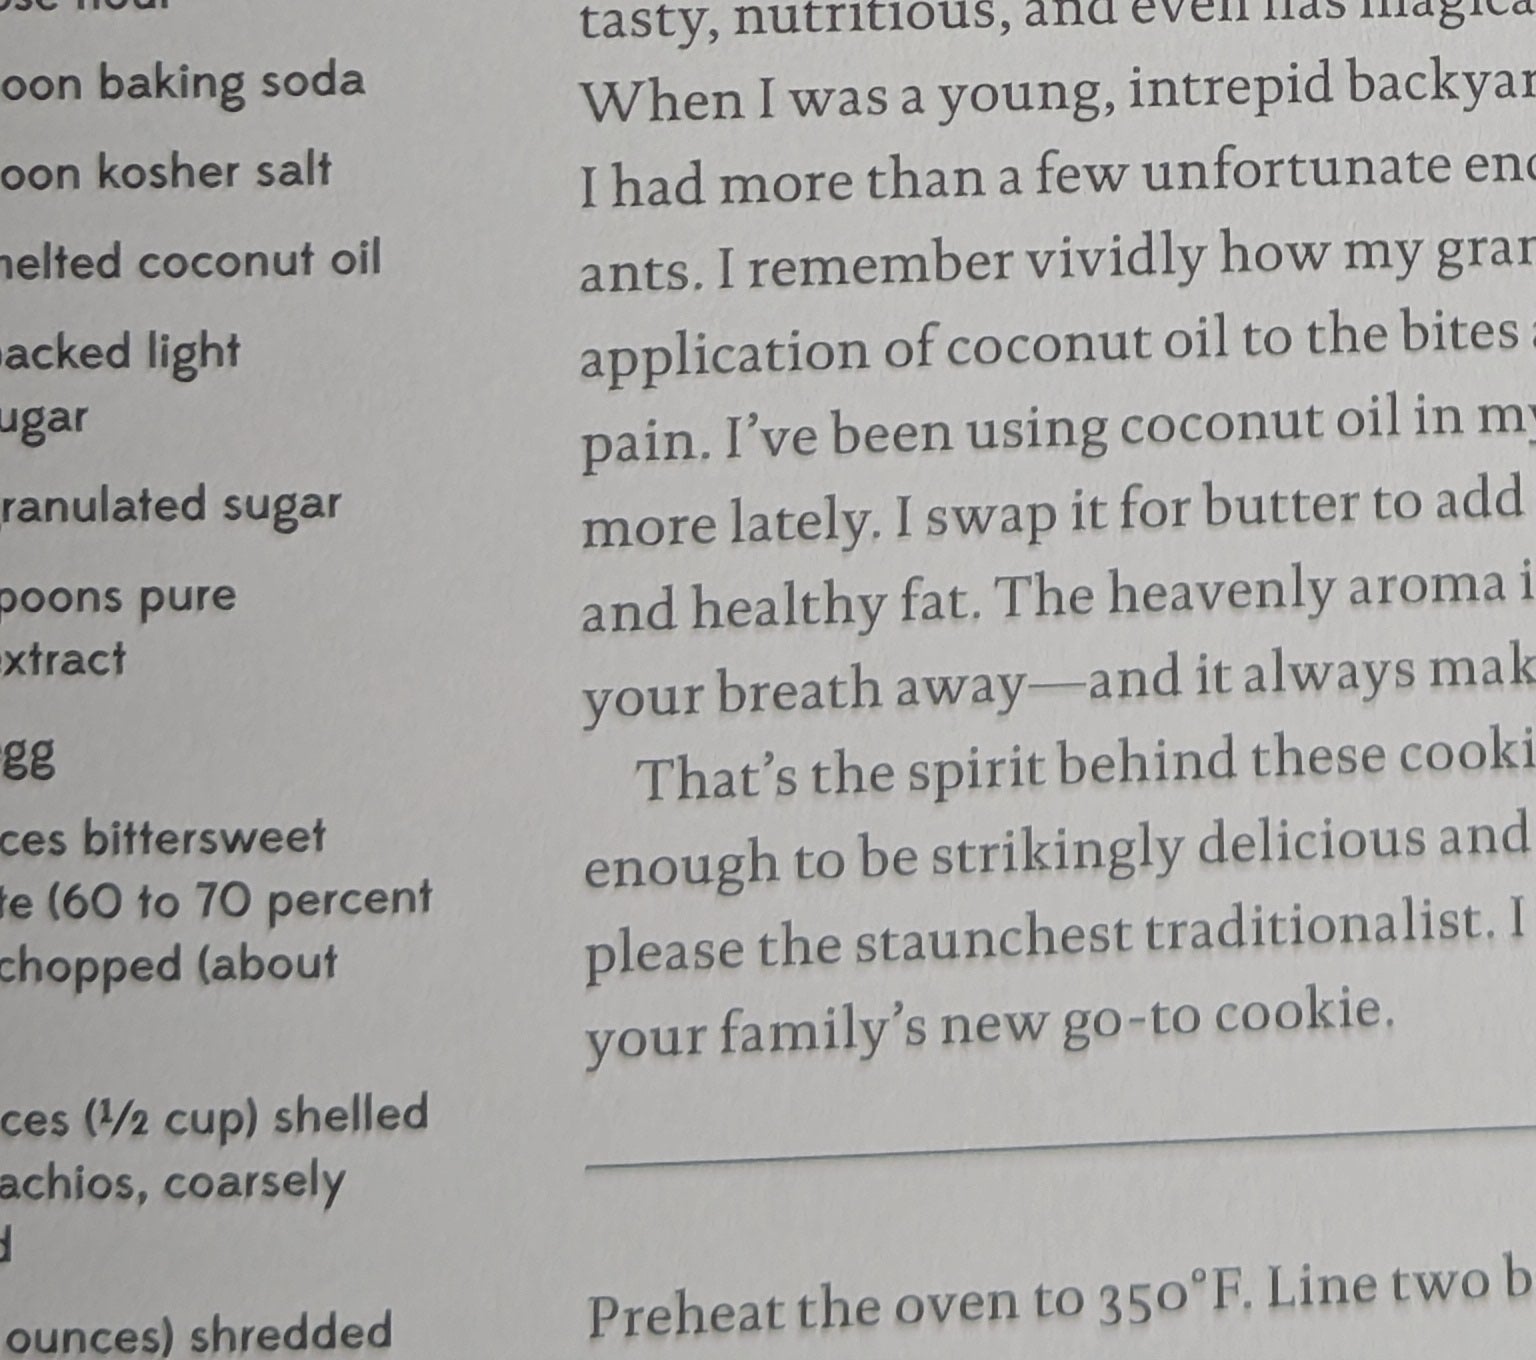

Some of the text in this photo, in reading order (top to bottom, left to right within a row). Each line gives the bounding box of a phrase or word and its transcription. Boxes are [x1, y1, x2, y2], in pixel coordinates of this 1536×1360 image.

[580, 4, 719, 50] tasty,
[100, 61, 245, 113] baking
[262, 58, 366, 97] soda
[579, 76, 745, 123] When
[760, 77, 774, 118] I
[788, 86, 887, 117] was
[902, 86, 925, 115] a
[938, 80, 1114, 127] young,
[1130, 58, 1334, 117] intrepid
[98, 150, 239, 189] kosher
[257, 148, 332, 187] salt
[138, 242, 314, 279] coconut
[331, 236, 380, 275] oil
[580, 258, 702, 293] ants.
[719, 248, 733, 289] I
[749, 236, 1014, 288] remember
[1026, 229, 1207, 288] vividly
[1220, 227, 1331, 273] how
[1344, 240, 1423, 282] my
[0, 329, 241, 383] acked light
[582, 419, 710, 477] pain.
[727, 412, 817, 459] I’ve
[830, 409, 953, 455] been
[966, 406, 1108, 460] using
[1121, 405, 1324, 445] coconut
[1337, 390, 1400, 438] oil
[1415, 393, 1464, 435] in
[0, 482, 342, 535] ranulated sugar
[583, 515, 716, 549] more
[731, 494, 880, 553] lately.
[897, 496, 911, 538] I
[927, 503, 1056, 547] swap
[1072, 489, 1107, 531] it
[1121, 483, 1191, 530] for
[1202, 480, 1360, 526] butter
[1374, 487, 1422, 521] to
[1437, 471, 1524, 519] add
[140, 586, 236, 624] pure
[0, 641, 126, 676] xtract
[583, 685, 704, 731] your
[716, 662, 882, 713] breath
[1197, 653, 1232, 695] it
[1245, 647, 1415, 703] always
[0, 739, 55, 781] gg
[636, 751, 797, 801] That’s
[812, 748, 894, 795] the
[910, 745, 1045, 804] spirit
[1057, 733, 1237, 785] behind
[1252, 731, 1385, 778] these
[84, 817, 326, 857] bittersweet
[48, 881, 121, 921] (60
[138, 885, 179, 919] to
[196, 881, 251, 918] 70
[269, 878, 432, 929] percent
[0, 942, 338, 995] chopped (about
[586, 927, 743, 988] please
[759, 920, 841, 967] the
[857, 910, 1132, 963] staunchest
[1146, 895, 1494, 951] traditionalist.
[1511, 896, 1523, 938] I
[586, 983, 1393, 1073] your family’s new go-to cookie.
[165, 1091, 428, 1147] cup) shelled
[164, 1158, 346, 1212] coarsely
[589, 1288, 784, 1340] Preheat
[798, 1282, 880, 1330] the
[896, 1291, 1019, 1324] oven
[1035, 1285, 1084, 1319] to
[1100, 1267, 1251, 1326] 350°F.
[1269, 1264, 1377, 1309] Line
[1392, 1269, 1489, 1303] two
[6, 1309, 391, 1358] ounces) shredded
